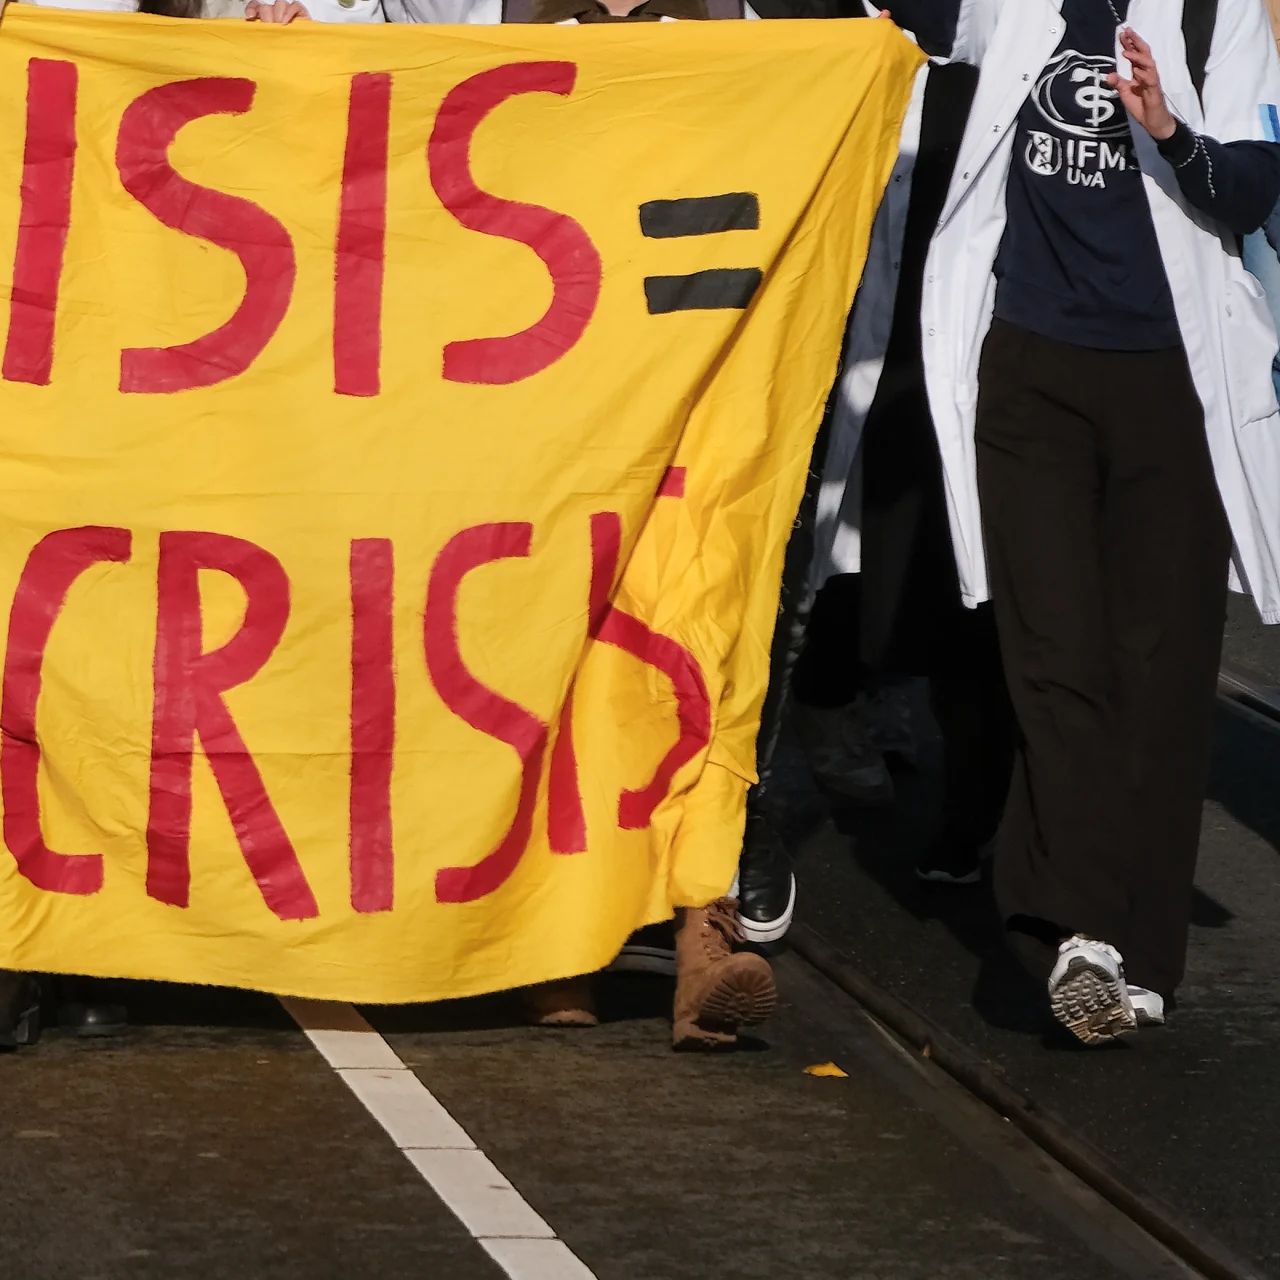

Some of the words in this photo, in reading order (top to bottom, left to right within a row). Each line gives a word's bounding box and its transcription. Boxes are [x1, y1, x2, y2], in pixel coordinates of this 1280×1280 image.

[1066, 138, 1127, 172] IFM
[1066, 166, 1107, 189] UvA
[636, 188, 764, 315] =
